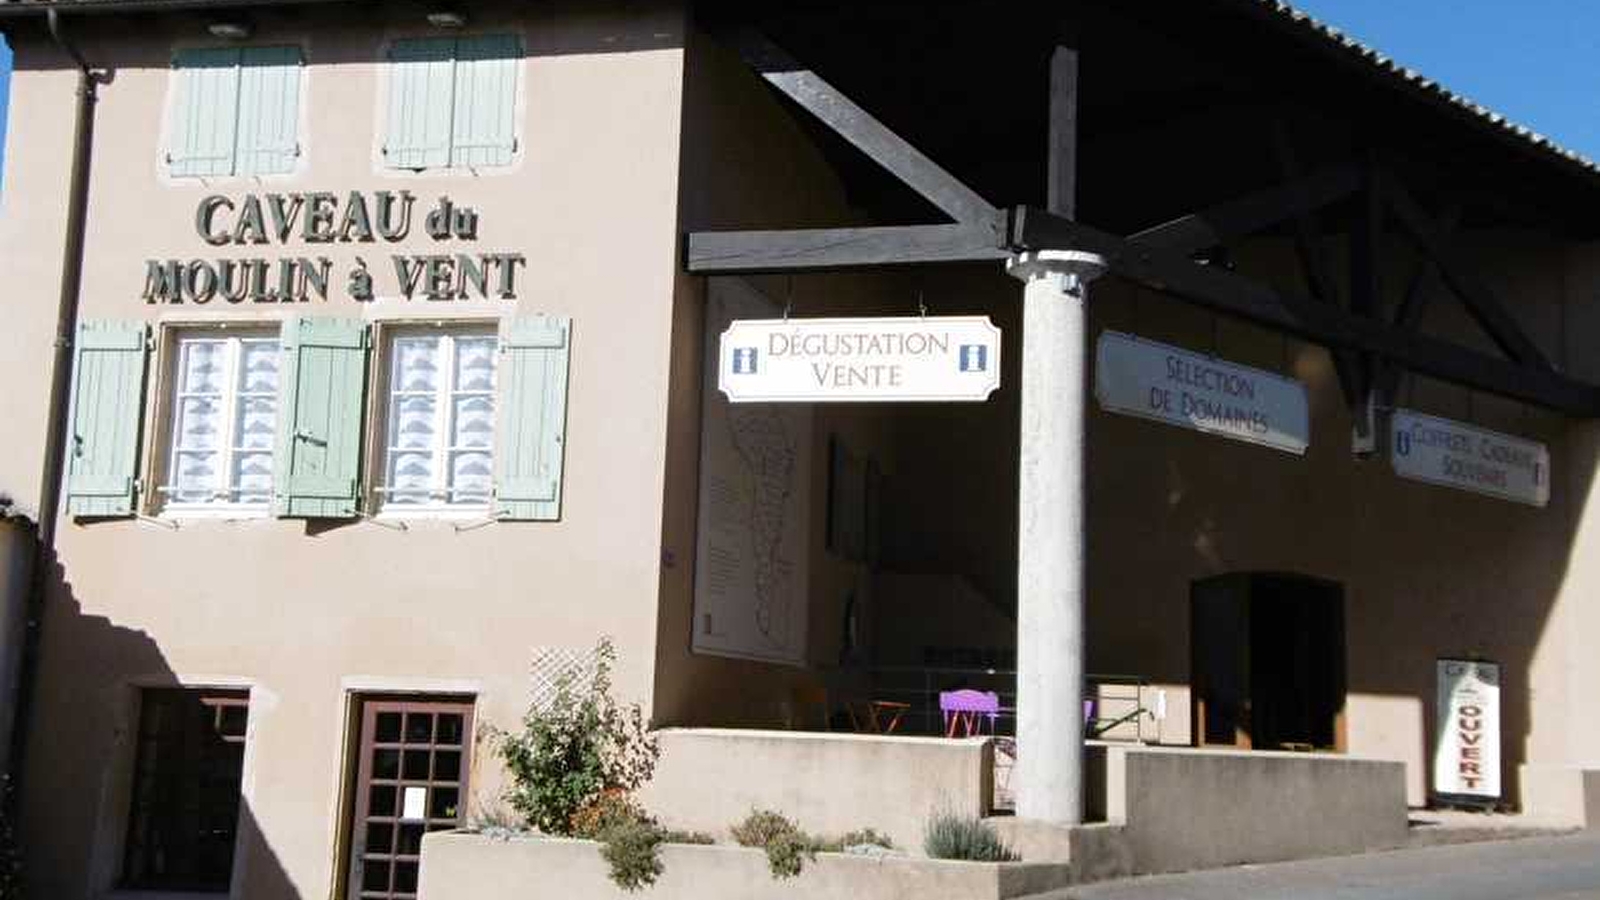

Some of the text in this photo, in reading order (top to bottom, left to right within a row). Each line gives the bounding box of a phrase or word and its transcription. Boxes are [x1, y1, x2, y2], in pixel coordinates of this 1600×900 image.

[196, 190, 479, 246] CAVEAU du
[142, 253, 526, 304] MOULIN à VENT
[768, 328, 949, 357] DÉGUSTATION
[811, 362, 902, 388] VENTE
[1166, 355, 1255, 399] SELECTION
[1151, 386, 1269, 434] DE DOMAINES
[1458, 704, 1482, 788] OUVERT
